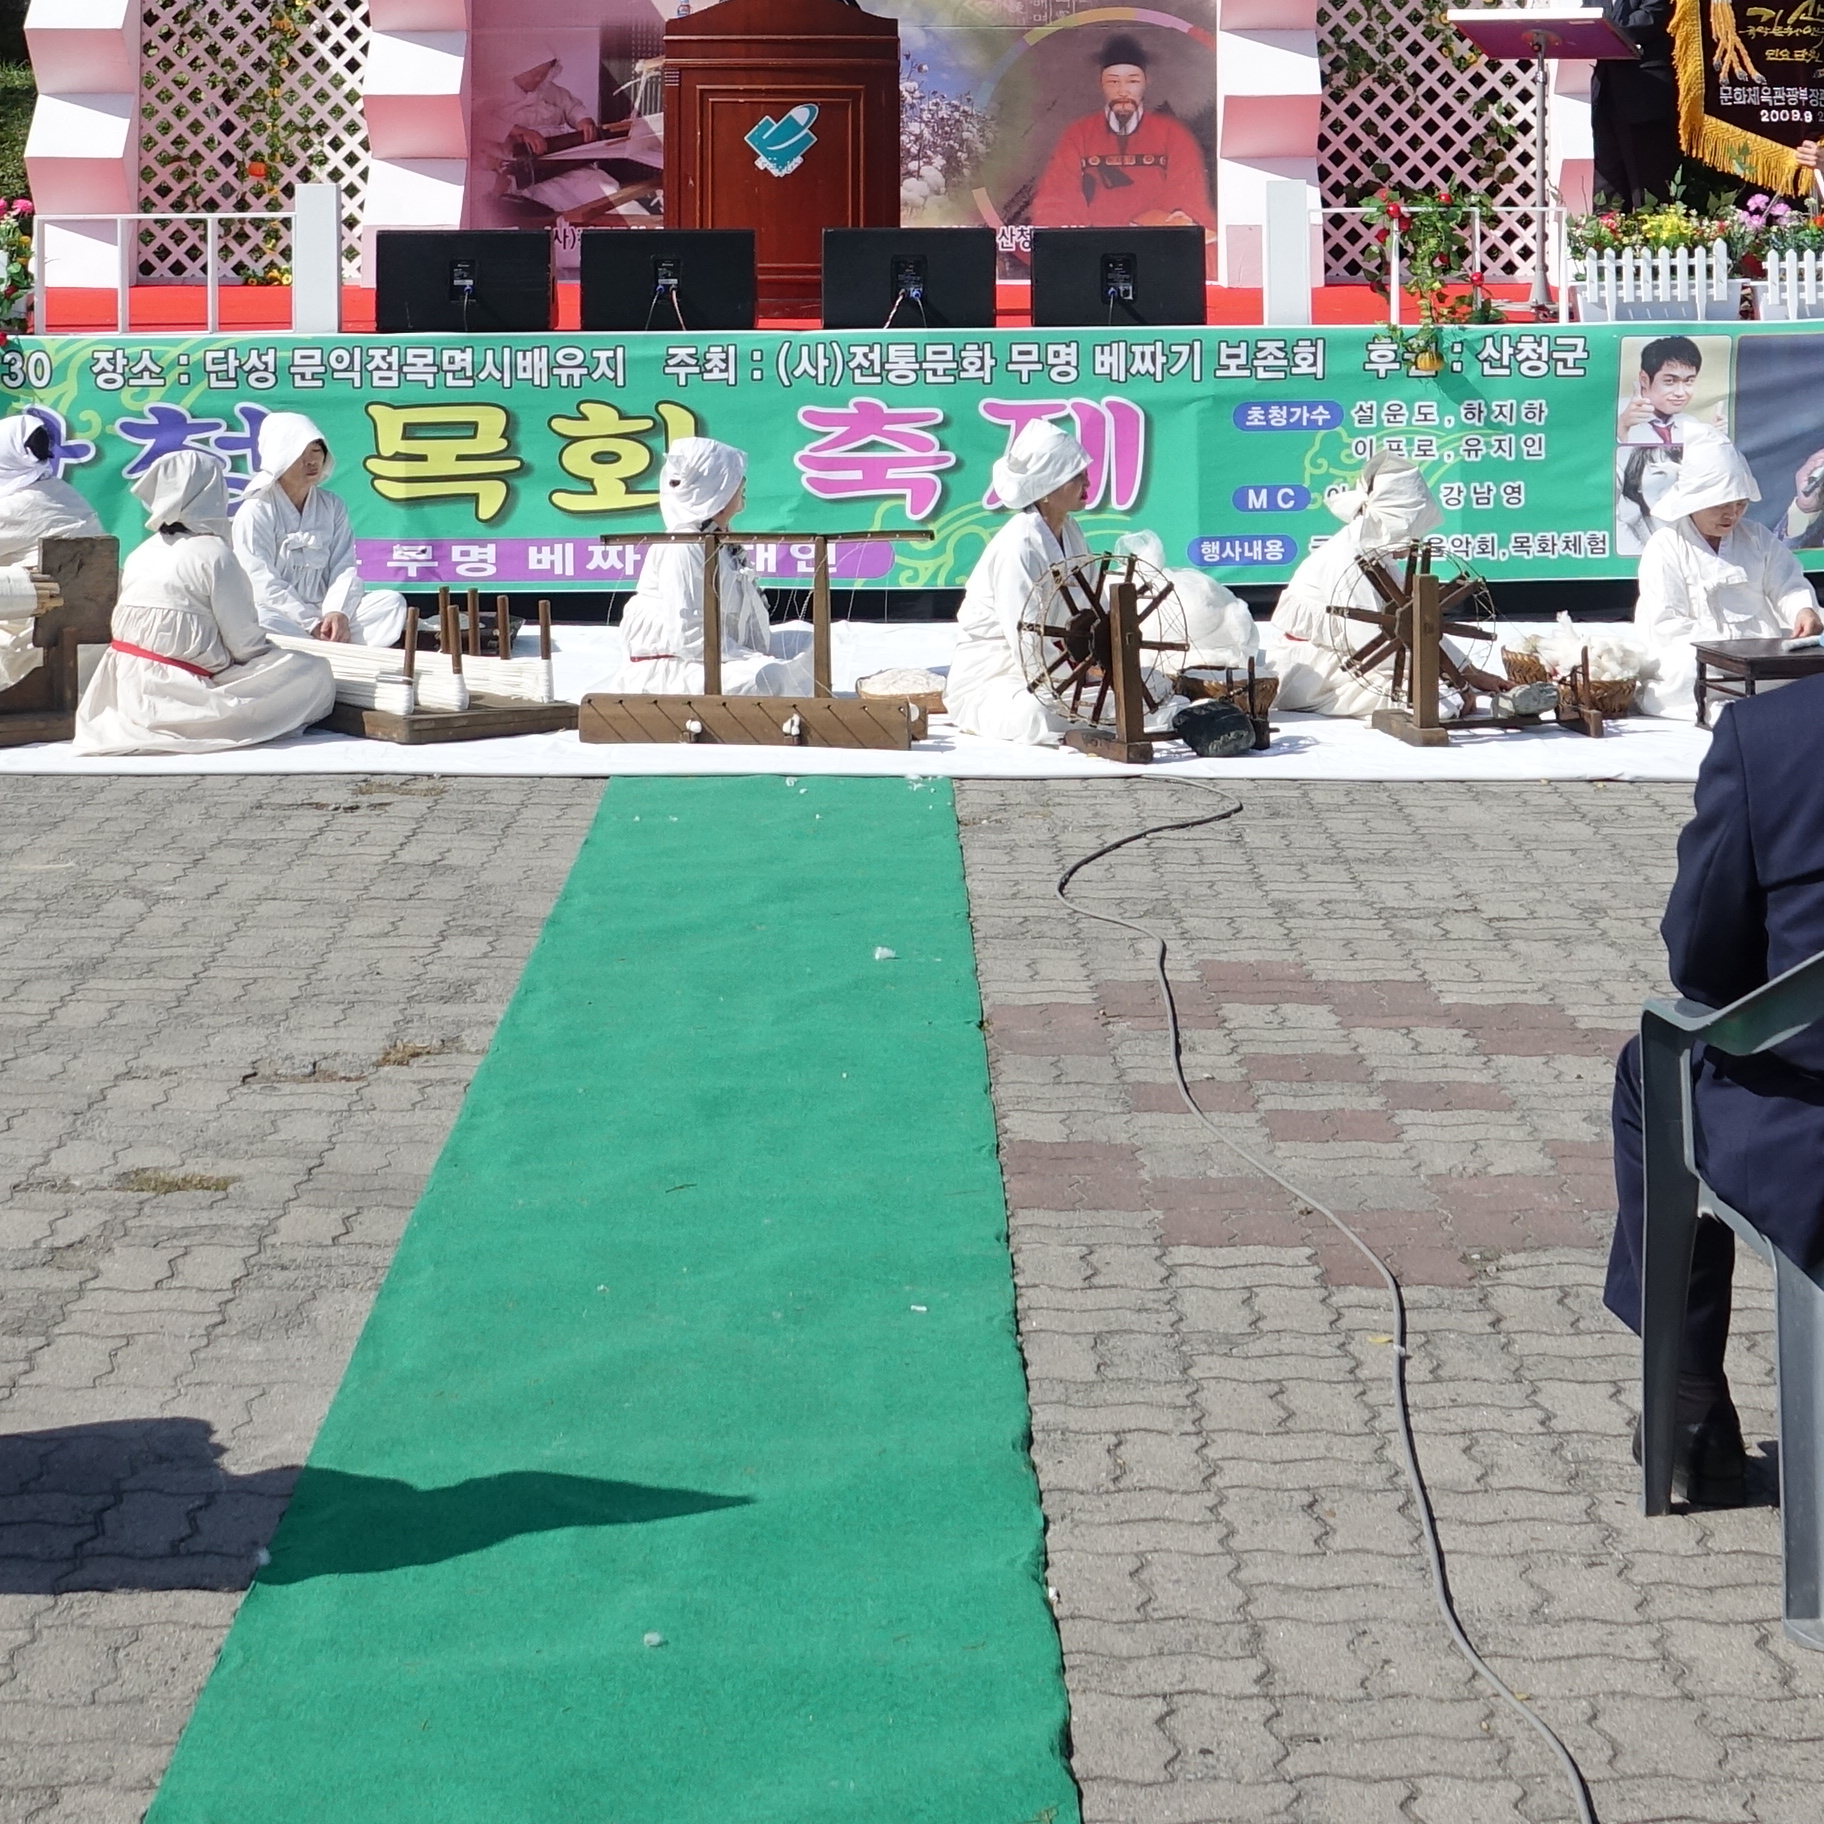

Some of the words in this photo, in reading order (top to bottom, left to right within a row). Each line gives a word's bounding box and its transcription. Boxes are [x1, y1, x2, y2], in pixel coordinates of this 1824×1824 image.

[90, 348, 167, 391] 장소
[202, 346, 279, 391] 단성
[289, 344, 627, 390] 문익점목면시배유지
[663, 343, 739, 387] 주최
[776, 340, 996, 388] (사)전통문화
[1006, 339, 1080, 385] 무명
[1092, 336, 1204, 383] 베짜기
[1213, 336, 1326, 380] 보존회
[1477, 334, 1590, 378] 산청군
[1244, 404, 1333, 428] 초청가수
[1440, 481, 1527, 509] 강남영
[386, 543, 499, 578] 무명
[527, 542, 643, 577] 베짜
[1199, 537, 1287, 562] 행사내용
